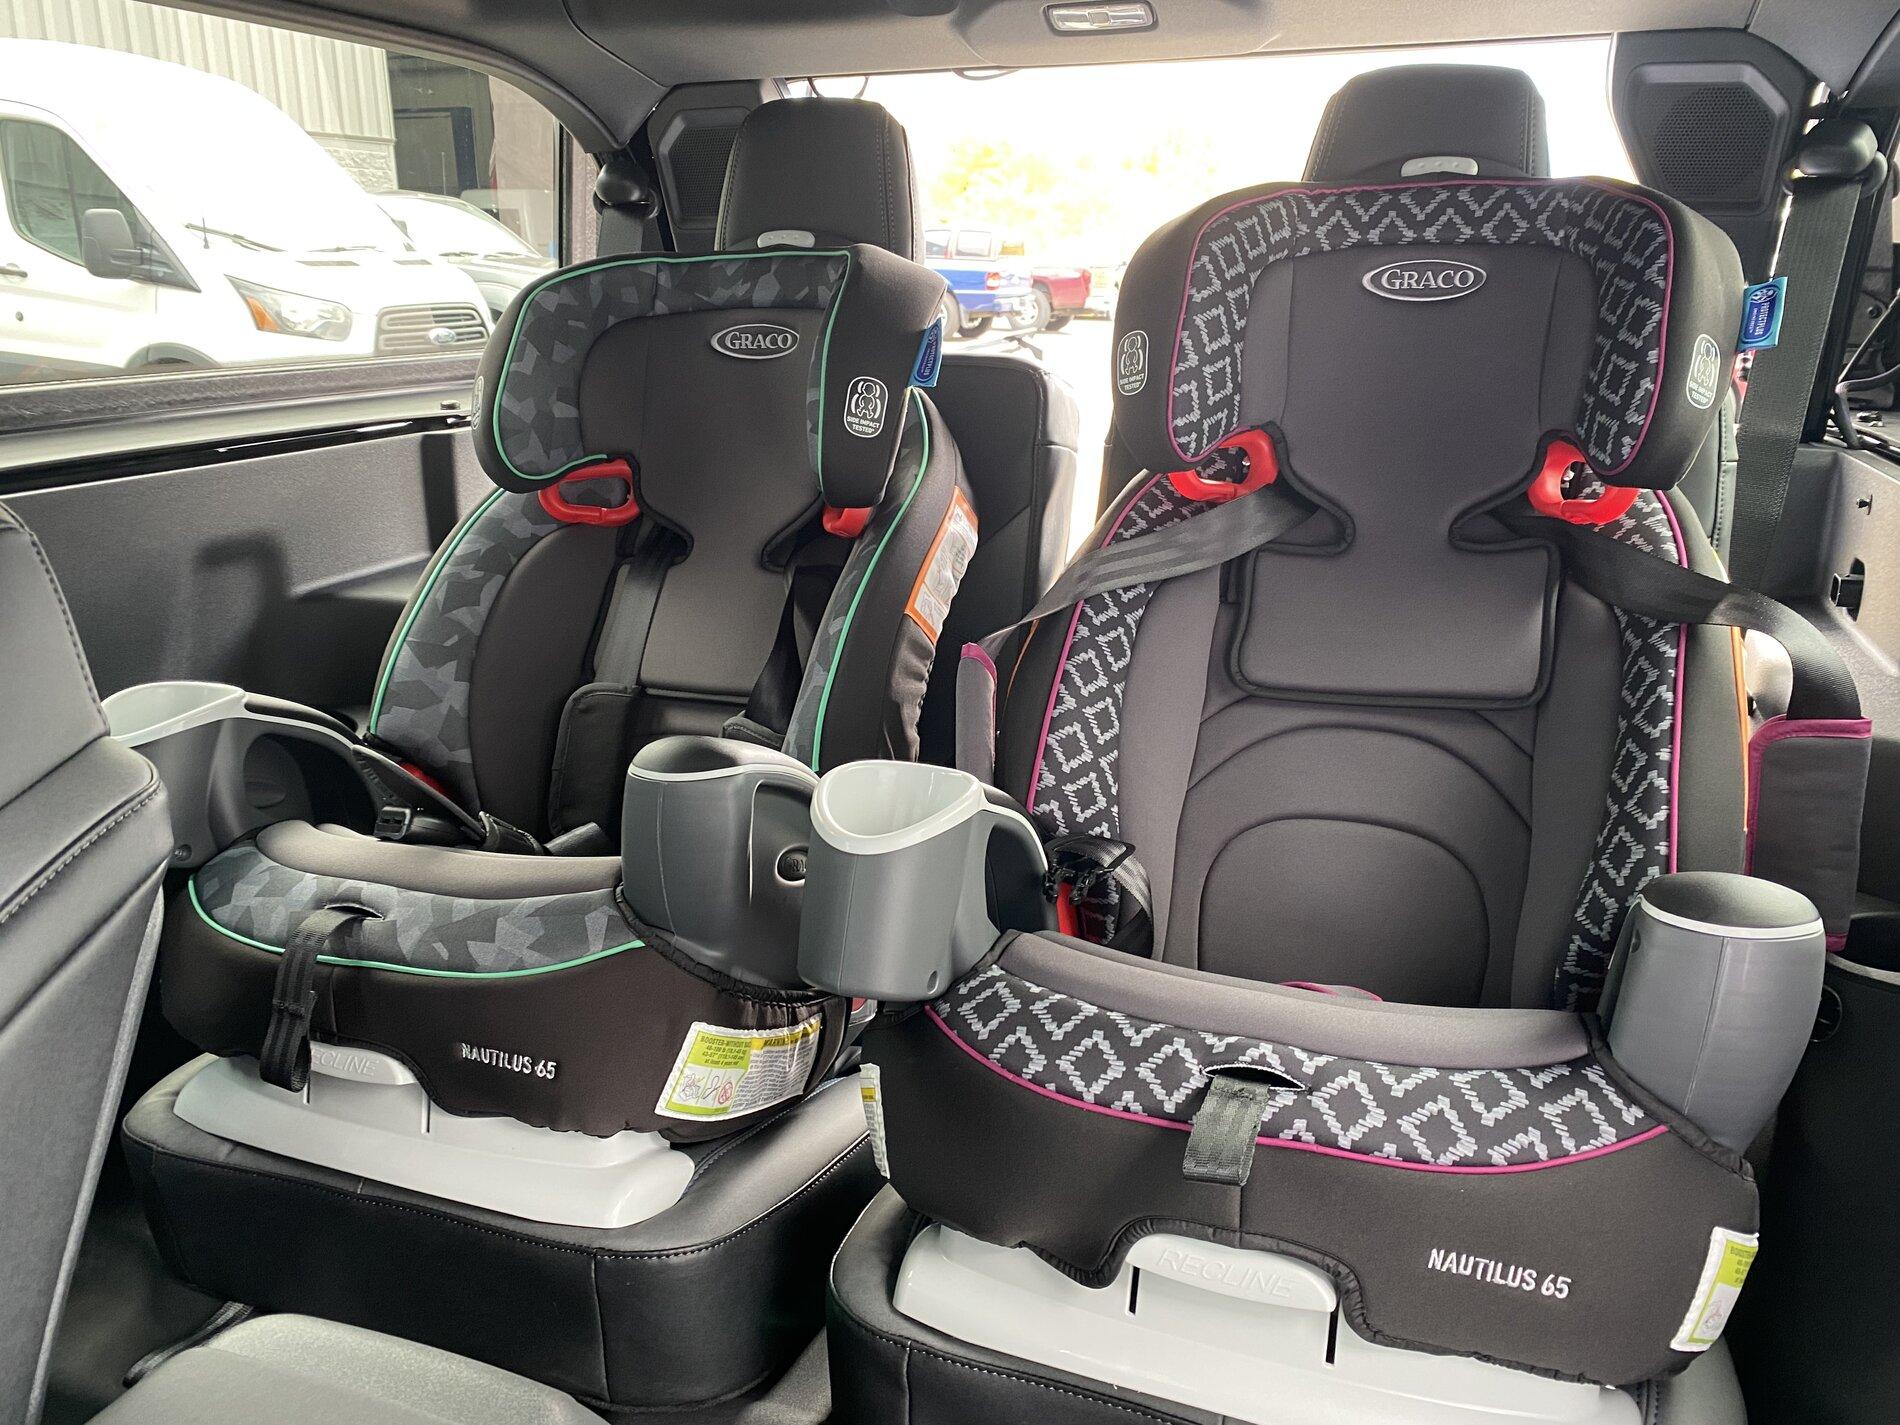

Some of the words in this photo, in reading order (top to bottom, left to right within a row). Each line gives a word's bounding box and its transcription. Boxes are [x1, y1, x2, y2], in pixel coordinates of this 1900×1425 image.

[1381, 268, 1475, 290] GRACO
[724, 331, 793, 350] GRACO
[846, 415, 860, 424] SIDE
[860, 418, 880, 428] IMPACT
[308, 1047, 380, 1077] ECLINE
[461, 1042, 532, 1074] NAUTILUS
[534, 1060, 557, 1080] 65
[1157, 1249, 1295, 1298] RECLINE
[1427, 1248, 1538, 1291] NAUTILUS
[1541, 1273, 1572, 1299] 65
